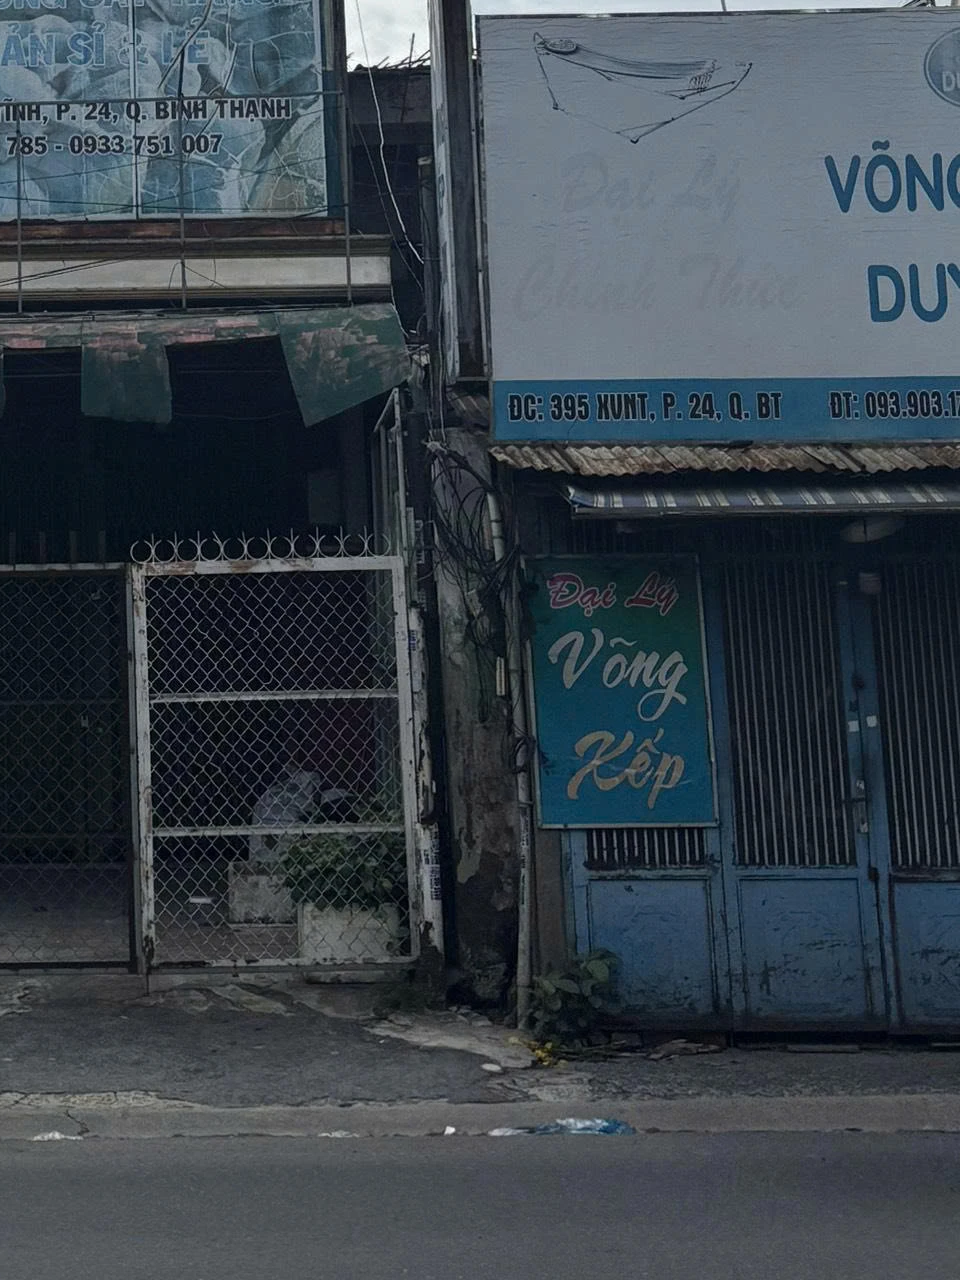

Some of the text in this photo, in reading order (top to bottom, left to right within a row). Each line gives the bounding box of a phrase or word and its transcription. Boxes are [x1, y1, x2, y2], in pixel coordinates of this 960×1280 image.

[67, 21, 106, 68] SỈ
[56, 102, 77, 121] P.
[84, 102, 119, 124] 24,
[125, 101, 149, 123] Q.
[215, 97, 291, 122] THẠNH
[6, 136, 48, 158] 785
[69, 135, 125, 155] 0933
[132, 135, 174, 155] 751
[181, 134, 224, 154] 007
[507, 393, 544, 422] ĐC:
[550, 392, 591, 422] 395
[661, 391, 683, 421] P.
[687, 391, 722, 422] 24,
[727, 391, 751, 422] Q.
[755, 391, 783, 421] BT
[828, 391, 861, 420] ĐT:
[546, 570, 679, 617] Đại Lý
[547, 627, 689, 723] Võng
[566, 727, 686, 810] Kếp
